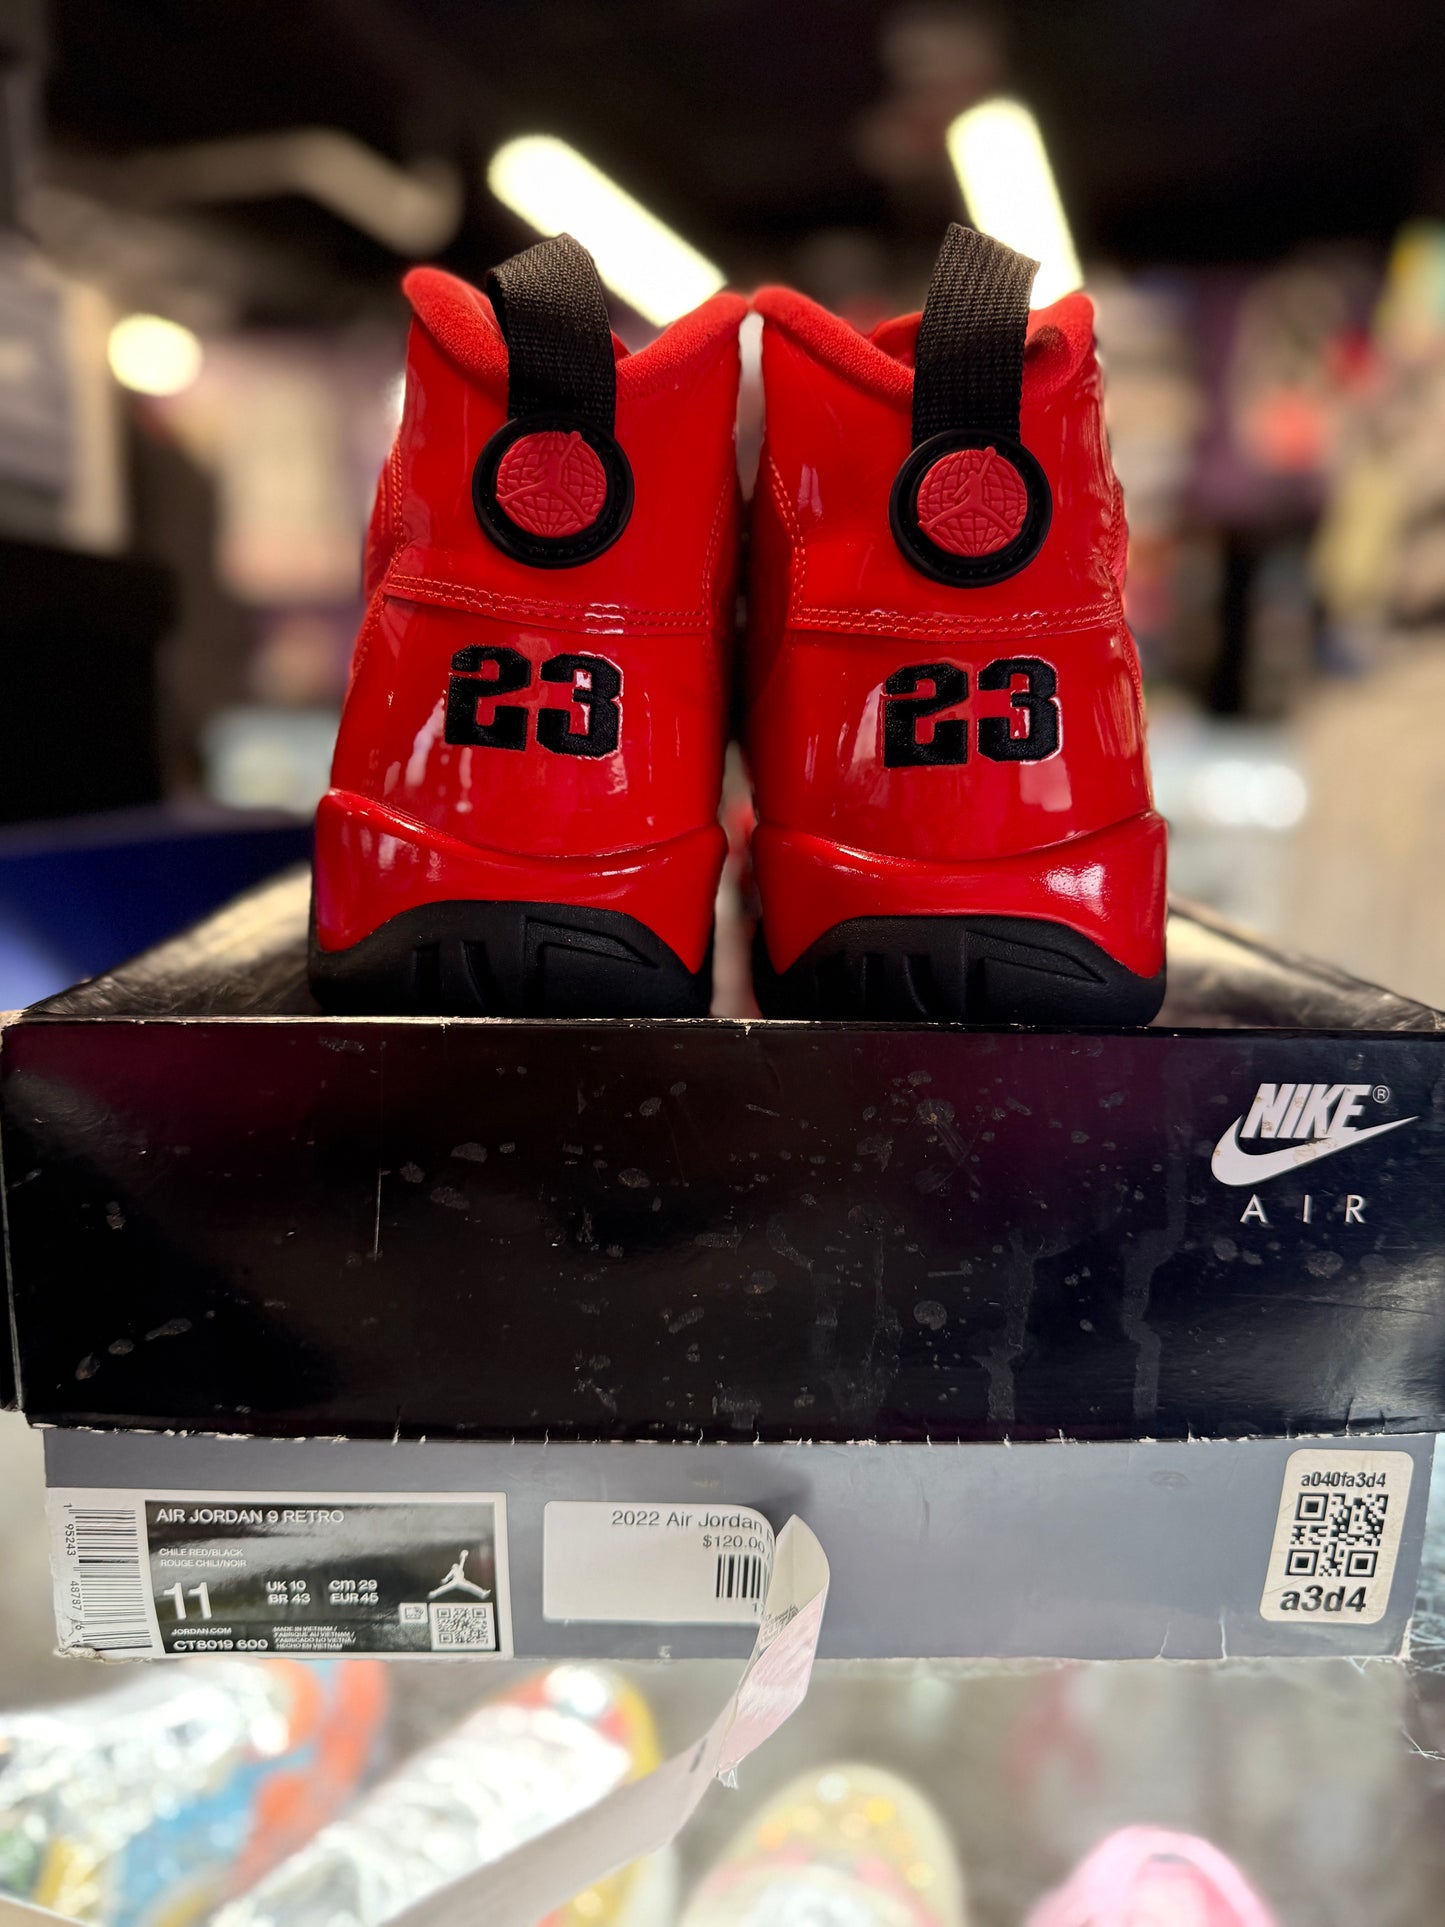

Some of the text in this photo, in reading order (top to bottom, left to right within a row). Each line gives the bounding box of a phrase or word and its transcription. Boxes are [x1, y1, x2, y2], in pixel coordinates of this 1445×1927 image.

[445, 644, 623, 760] 23
[884, 657, 1062, 768] 23
[1239, 1083, 1371, 1139] NIKE
[1240, 1194, 1366, 1224] AIR
[1301, 1471, 1386, 1488] a040fa3d4
[155, 1508, 345, 1524] AIR JORDAN 9 RETRO
[611, 1510, 763, 1534] 2022 Air Jordan
[64, 1523, 77, 1556] 95243
[702, 1534, 765, 1554] $120.00
[160, 1548, 244, 1557] CHILE RED/BLACK
[161, 1559, 247, 1568] ROUGE CHILI/NOIR
[70, 1580, 82, 1611] 48787
[266, 1580, 307, 1593] UK 10
[358, 1579, 378, 1592] 29
[164, 1582, 212, 1620] 11
[267, 1593, 311, 1605] BR 43
[1280, 1584, 1366, 1612] a3d4
[170, 1627, 232, 1636] JORDAN.COM
[173, 1639, 269, 1651] CT8019 600
